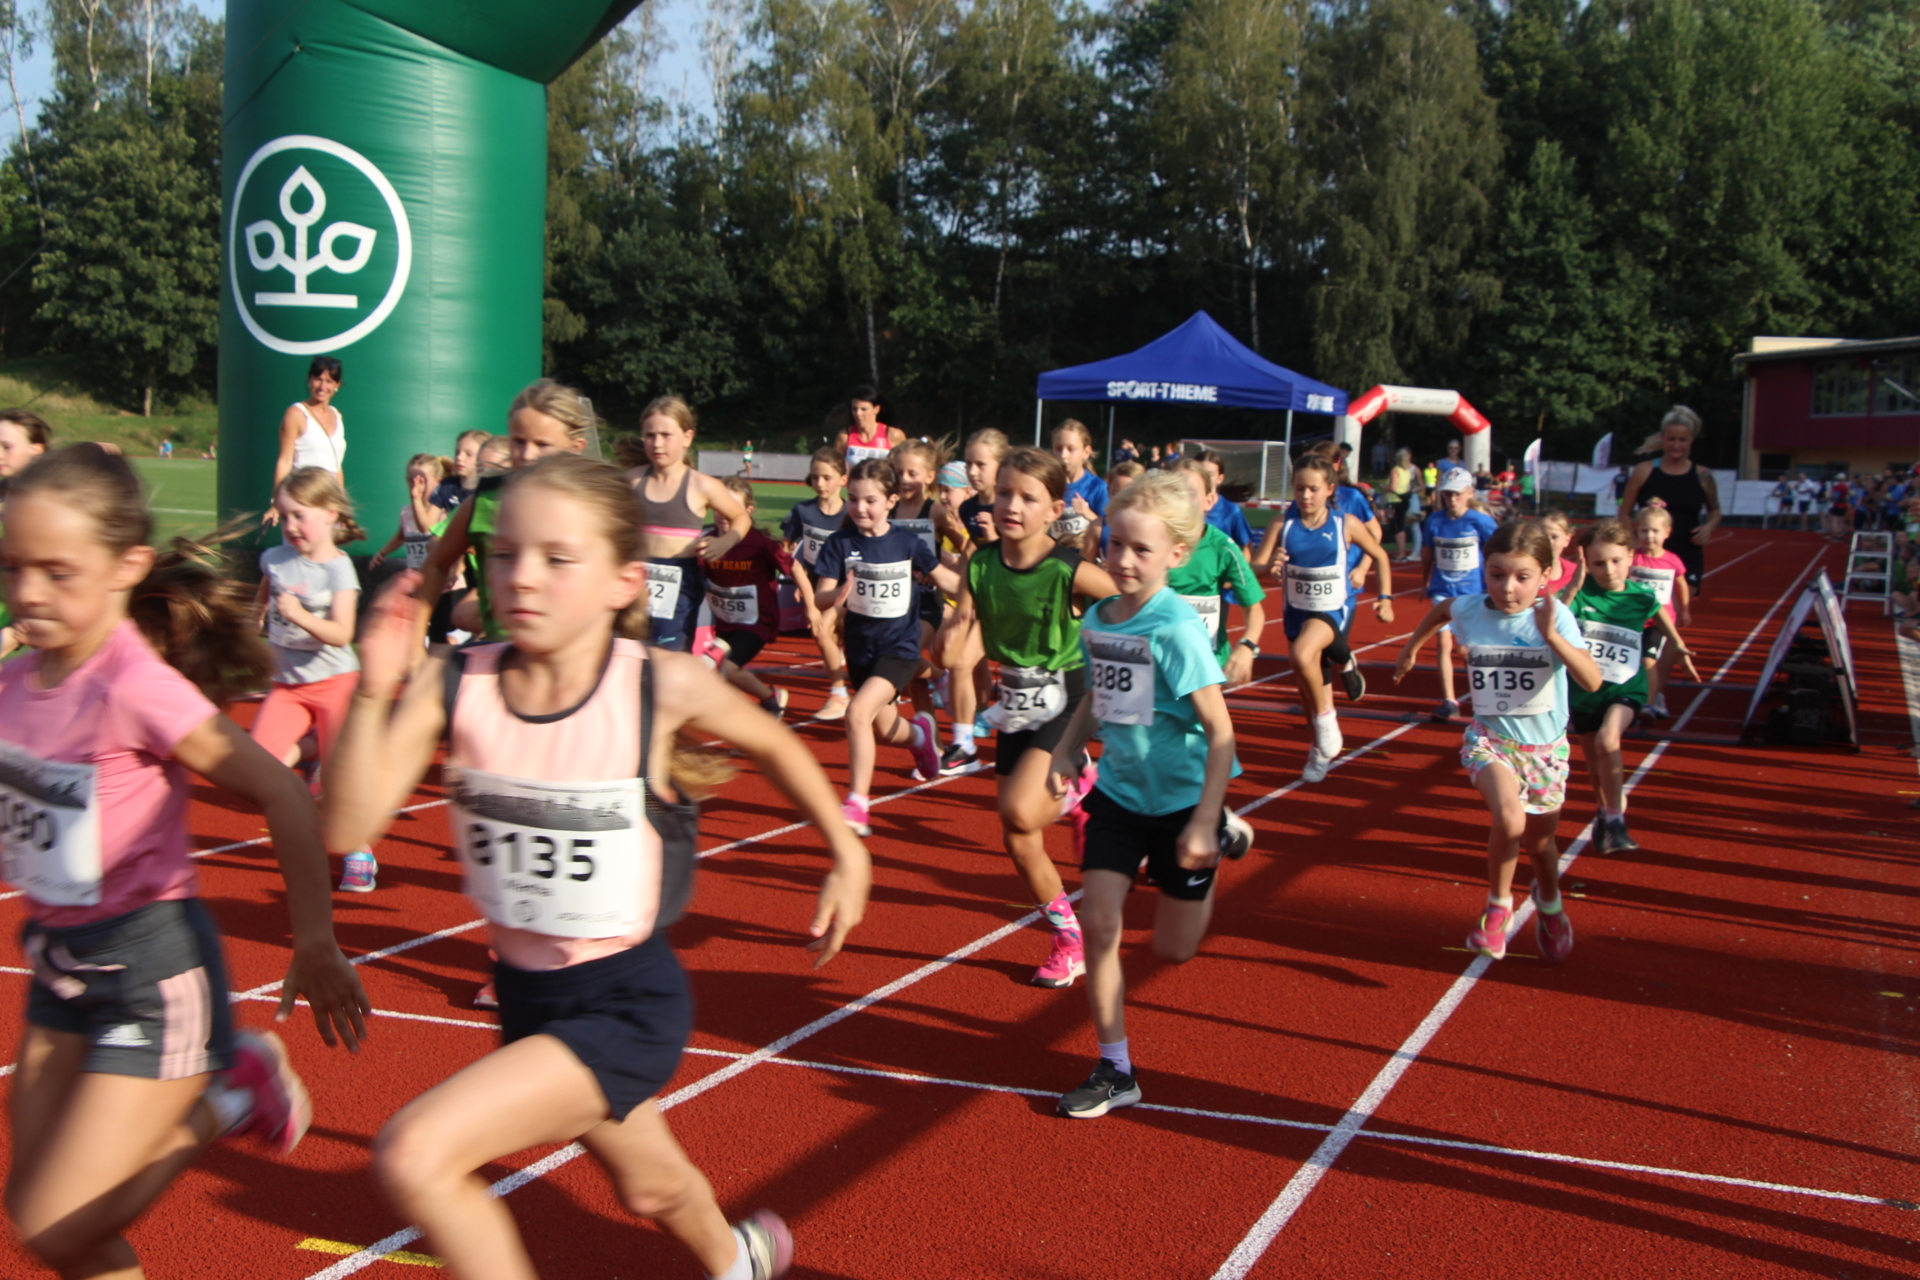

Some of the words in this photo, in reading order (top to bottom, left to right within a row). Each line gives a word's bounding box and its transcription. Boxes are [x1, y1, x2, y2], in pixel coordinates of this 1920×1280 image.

[1107, 380, 1218, 402] SPORT-THIEME
[1441, 549, 1470, 559] 8275
[723, 560, 753, 571] READY
[856, 581, 901, 598] 8128
[1295, 582, 1333, 595] 8298
[711, 596, 746, 612] 8258
[1472, 670, 1535, 690] 8136
[467, 823, 596, 881] 8135
